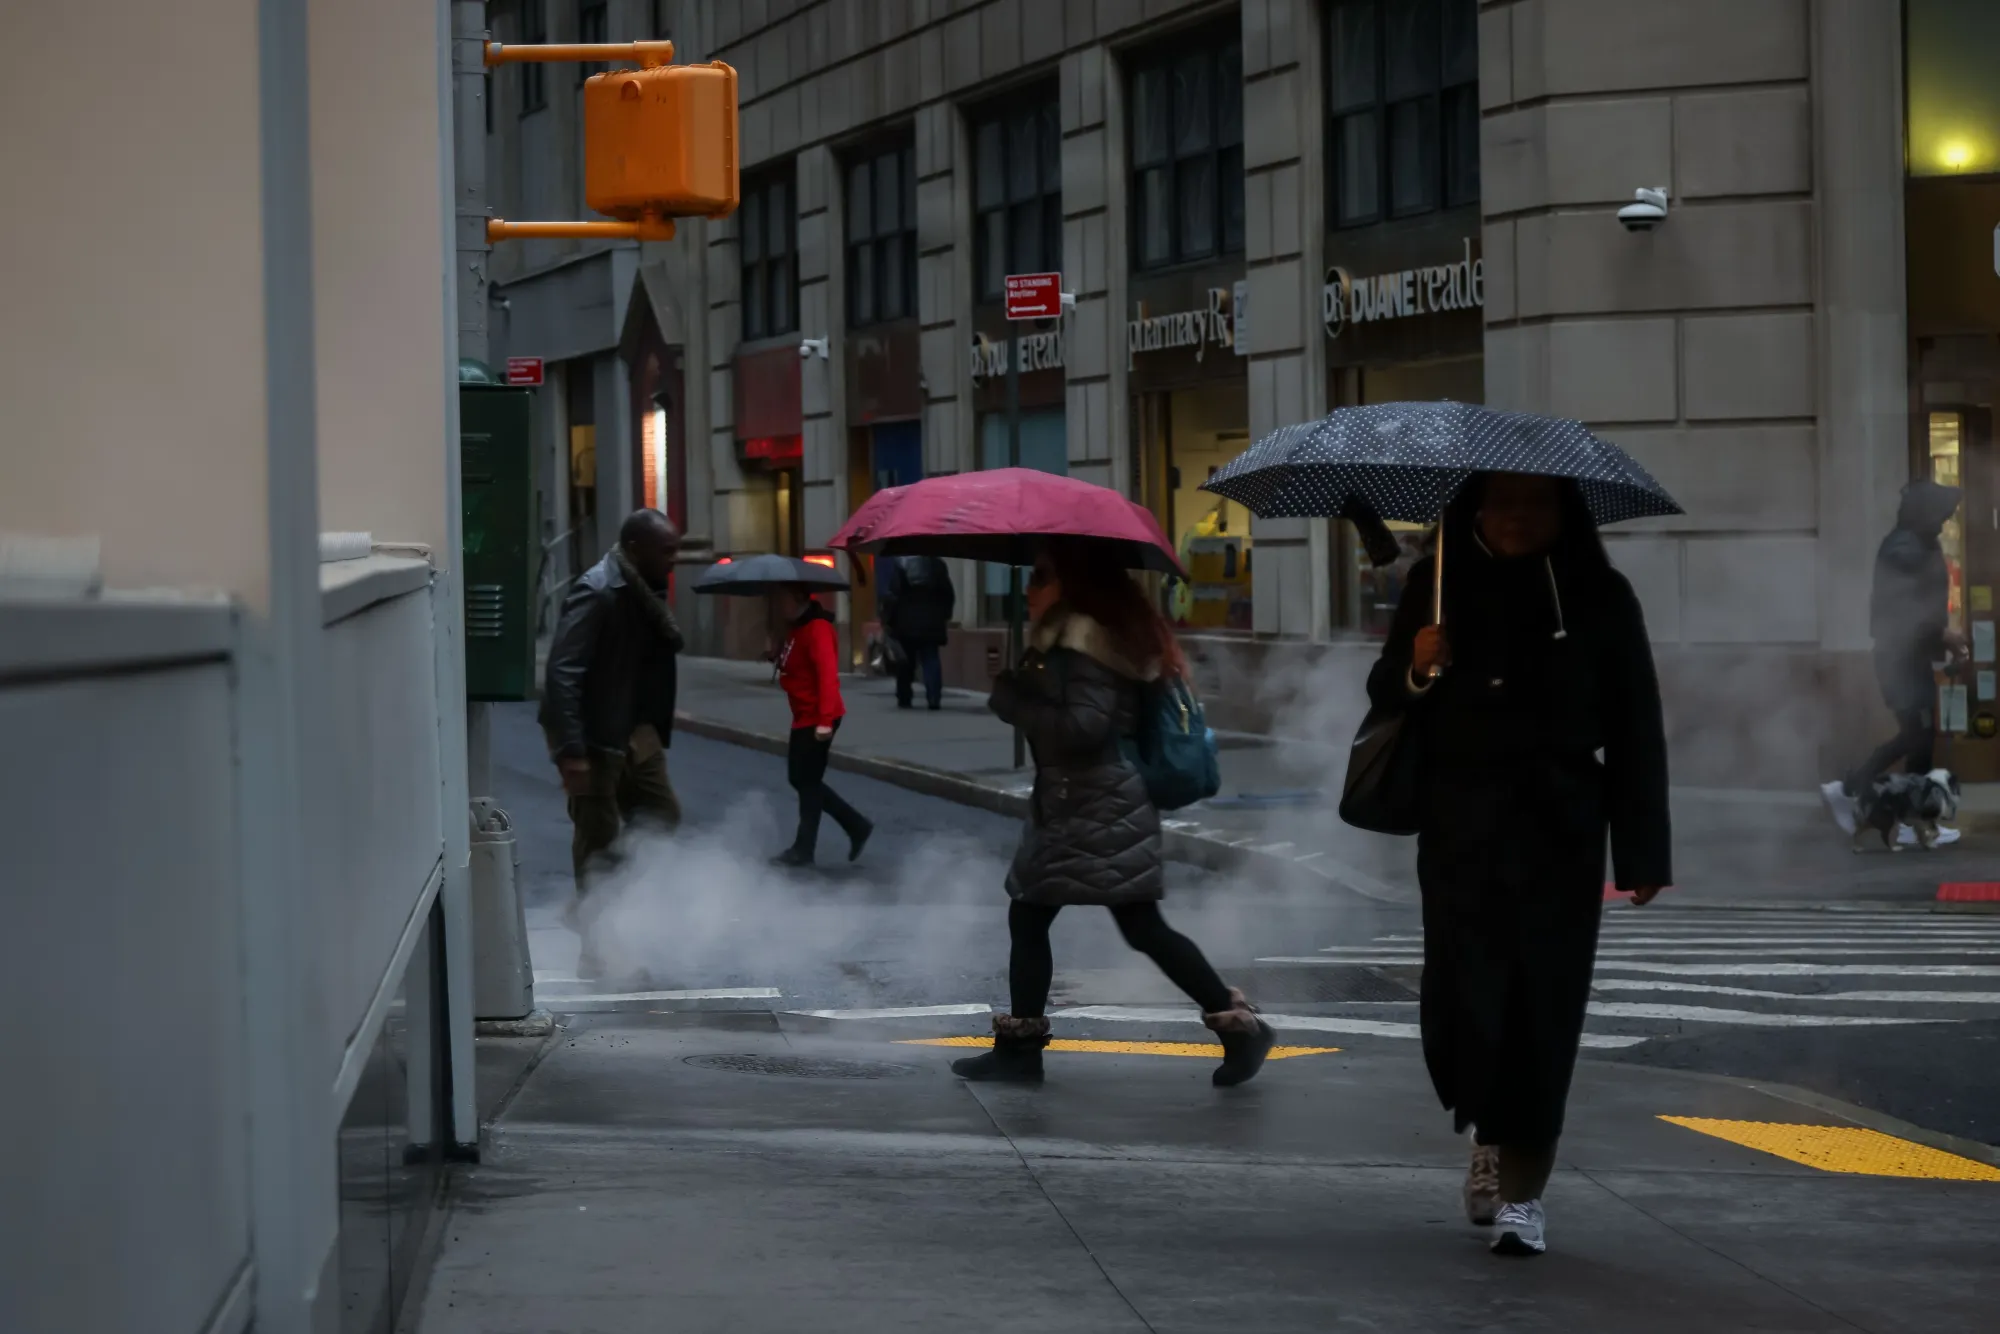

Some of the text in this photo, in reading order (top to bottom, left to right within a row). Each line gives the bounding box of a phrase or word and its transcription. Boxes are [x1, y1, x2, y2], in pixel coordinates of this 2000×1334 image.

[1008, 278, 1052, 288] NO STANDING
[1128, 301, 1209, 372] pharmacy
